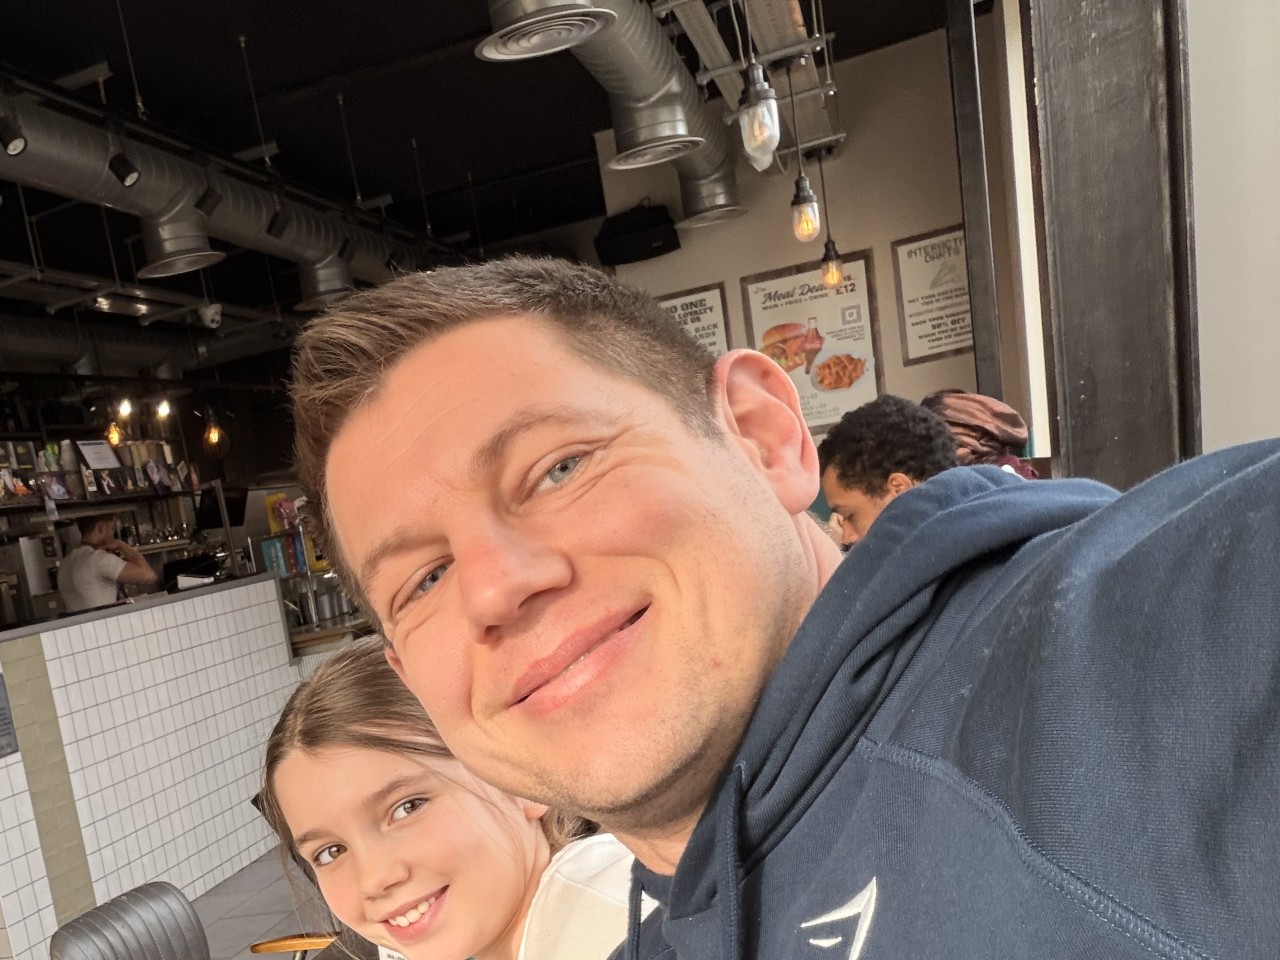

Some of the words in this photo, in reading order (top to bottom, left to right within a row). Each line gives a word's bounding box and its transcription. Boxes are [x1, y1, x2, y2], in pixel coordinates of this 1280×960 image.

[761, 287, 796, 305] Meal
[835, 282, 856, 295] £12
[680, 298, 707, 312] ONE
[677, 306, 714, 320] LOYALTY
[695, 322, 718, 334] BACK
